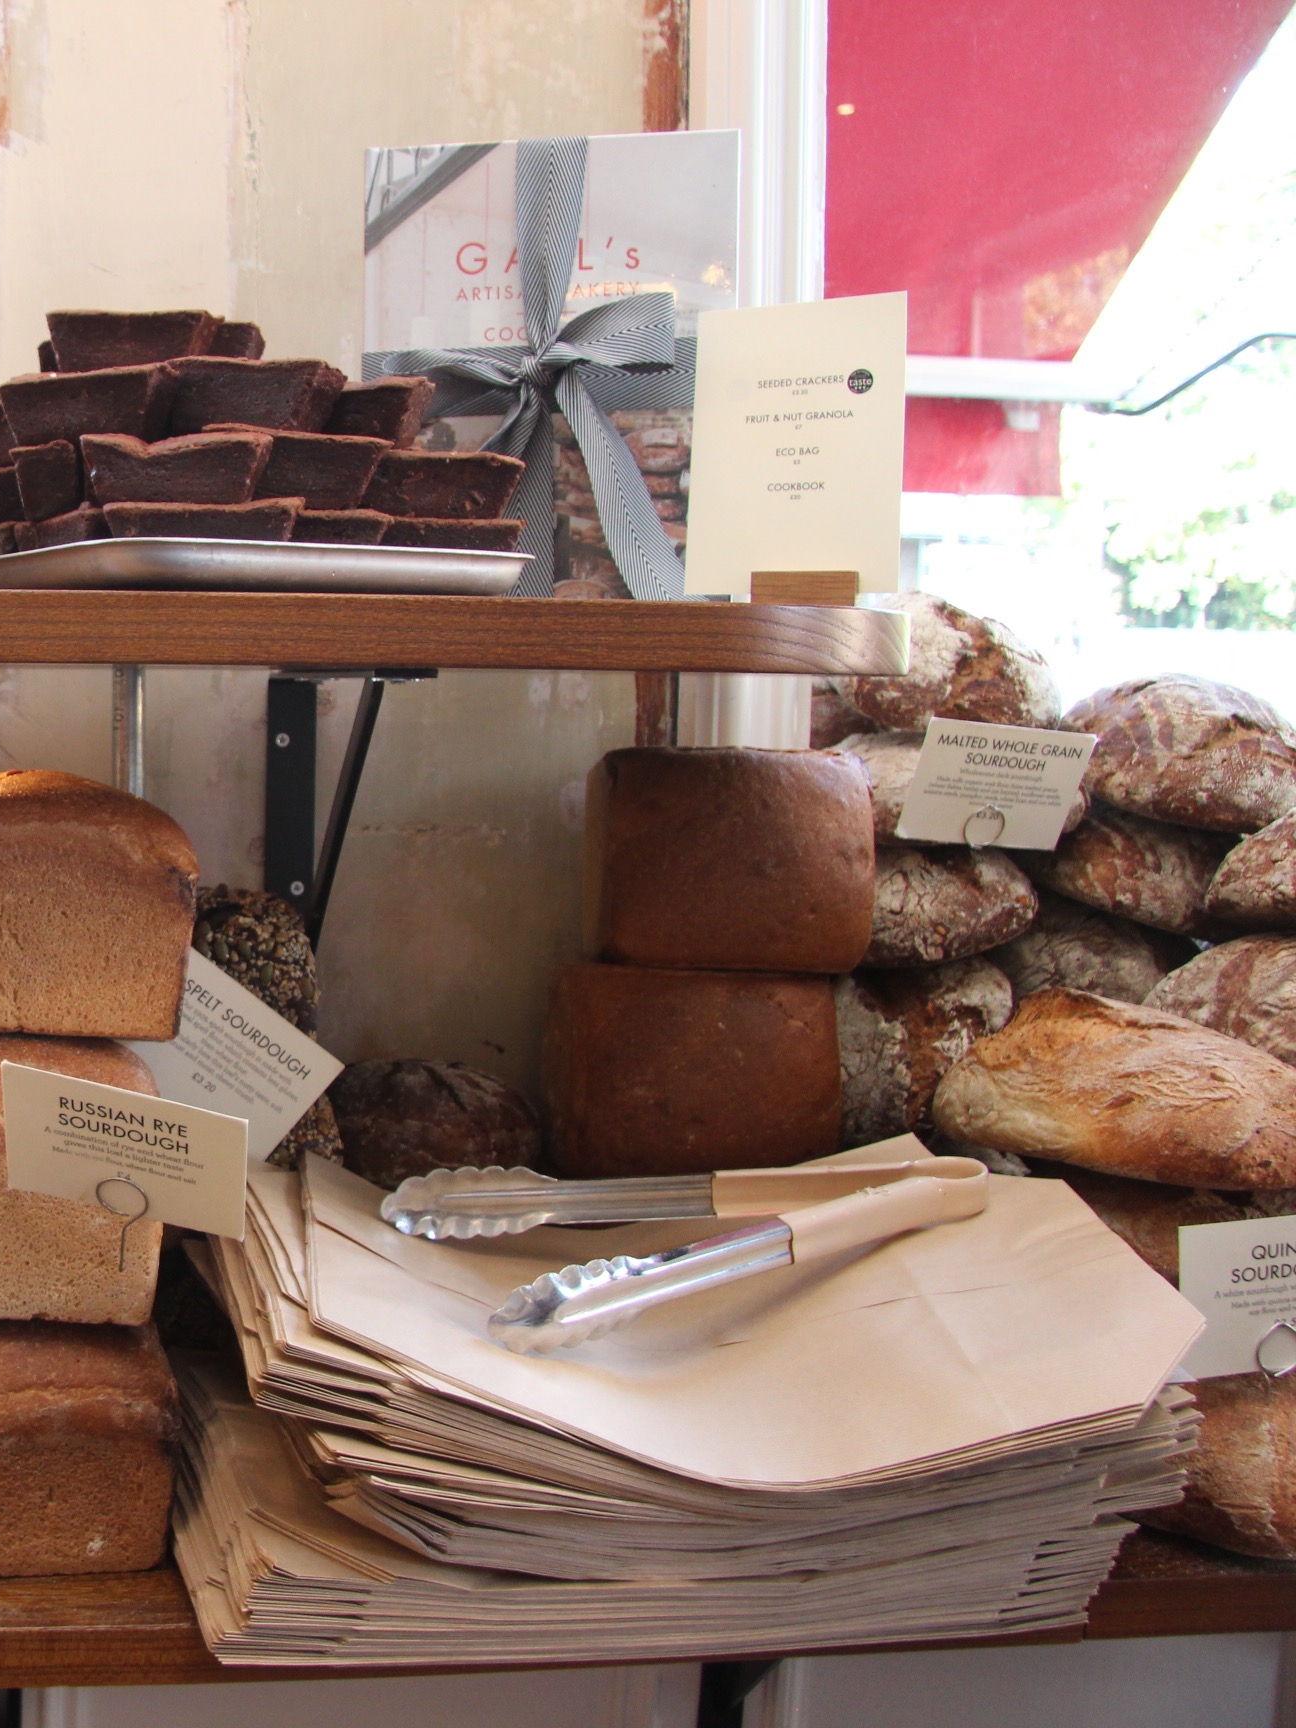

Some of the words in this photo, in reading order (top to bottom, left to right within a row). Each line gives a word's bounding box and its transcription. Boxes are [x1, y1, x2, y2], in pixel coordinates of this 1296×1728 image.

[456, 237, 640, 275] GL's
[456, 285, 524, 302] ARTIS
[572, 281, 640, 299] AKERY
[757, 378, 793, 389] SEEDED
[795, 374, 845, 386] CRACKERS
[745, 414, 770, 424] FRUIT
[773, 414, 780, 423] &
[783, 412, 803, 422] NUT
[805, 410, 854, 421] GRANOLA
[775, 448, 797, 457] ECO
[799, 446, 820, 456] BAG
[767, 481, 826, 492] COOKBOOK
[937, 733, 988, 749] MALTED
[992, 739, 1039, 755] WHOLE
[1041, 744, 1083, 759] GRAIN
[964, 752, 1047, 771] SOURDOUGH
[184, 979, 223, 1012] SPELT
[221, 1008, 312, 1080] SOURDOUGH
[59, 1095, 145, 1128] RUSSIAN
[154, 1118, 188, 1138] RYE
[58, 1112, 189, 1155] SOURDOUGH
[43, 1125, 52, 1134] A
[53, 1126, 107, 1147] combination
[109, 1140, 119, 1149] of
[120, 1143, 134, 1154] rye
[136, 1146, 153, 1157] and
[154, 1150, 182, 1164] wheat
[183, 1157, 204, 1170] flour
[63, 1138, 87, 1151] gives
[88, 1143, 105, 1154] this
[106, 1147, 123, 1158] loaf
[131, 1153, 162, 1168] lighter
[162, 1161, 185, 1174] taste
[1231, 1263, 1296, 1284] SOURD
